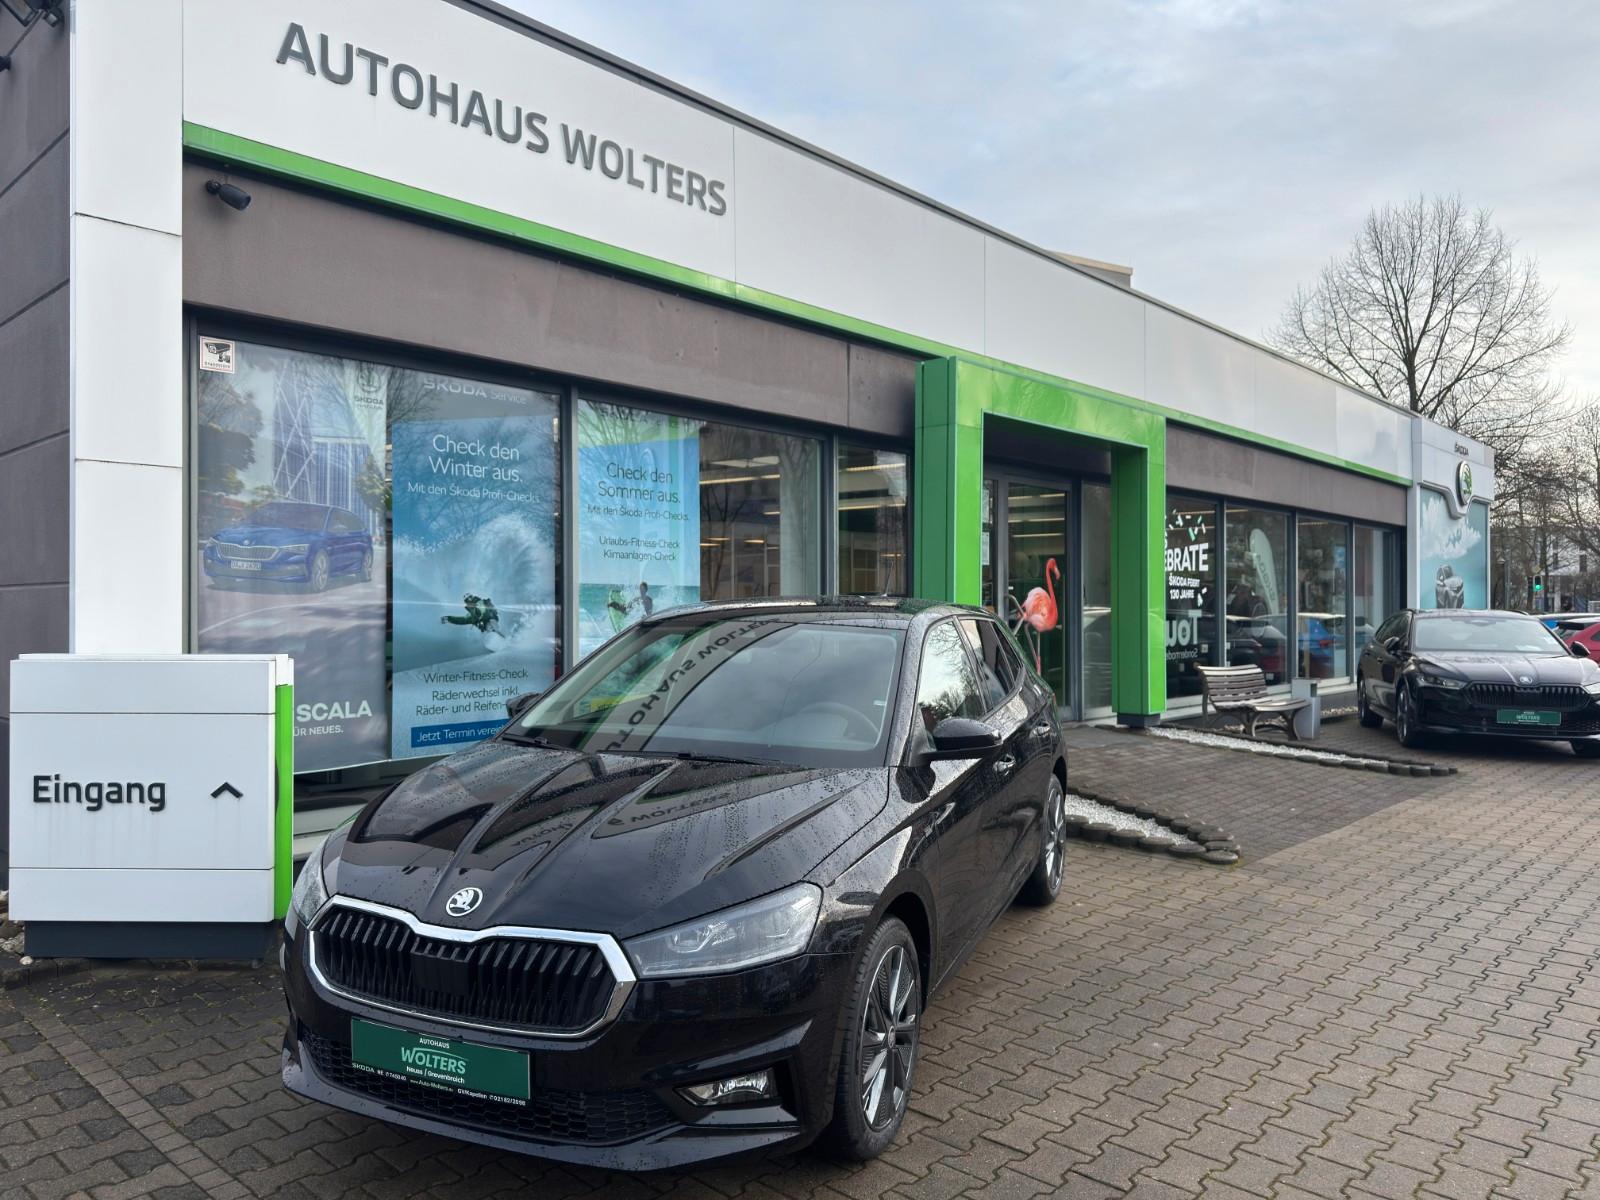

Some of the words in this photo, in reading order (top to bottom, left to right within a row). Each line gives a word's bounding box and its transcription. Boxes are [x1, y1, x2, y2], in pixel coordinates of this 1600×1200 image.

[276, 22, 550, 155] AUTOHAUS
[561, 123, 727, 216] WOLTERS
[432, 434, 485, 456] Check
[489, 443, 520, 461] den
[428, 456, 488, 478] Winter
[492, 467, 523, 482] aus.
[606, 462, 647, 481] Check
[650, 468, 673, 484] den
[407, 482, 426, 494] Mit
[427, 485, 447, 495] den
[450, 482, 481, 498] Škoda
[598, 481, 654, 500] Sommer
[657, 490, 681, 503] aus.
[603, 506, 618, 515] den
[619, 505, 643, 518] Škoda
[599, 536, 680, 549] Urlaubs-Fitness-Check
[603, 549, 677, 561] Klimaanlagen-Check
[1169, 589, 1180, 600] 130
[1180, 588, 1195, 600] JAHRE
[423, 668, 529, 684] Winter-Fitness-Check
[432, 687, 500, 701] Räderwechsel
[501, 685, 520, 697] inkl.
[296, 700, 373, 722] SCALA
[416, 704, 449, 716] Räder-
[451, 704, 471, 714] und
[309, 725, 345, 736] NEUES.
[416, 731, 441, 743] Jetzt
[444, 728, 476, 739] Termin
[32, 774, 167, 813] Eingang
[419, 1037, 450, 1049] AUTOHAUS
[401, 1046, 467, 1075] WOLTERS
[406, 1065, 423, 1076] Neuss
[428, 1070, 465, 1085] Grevenbroich
